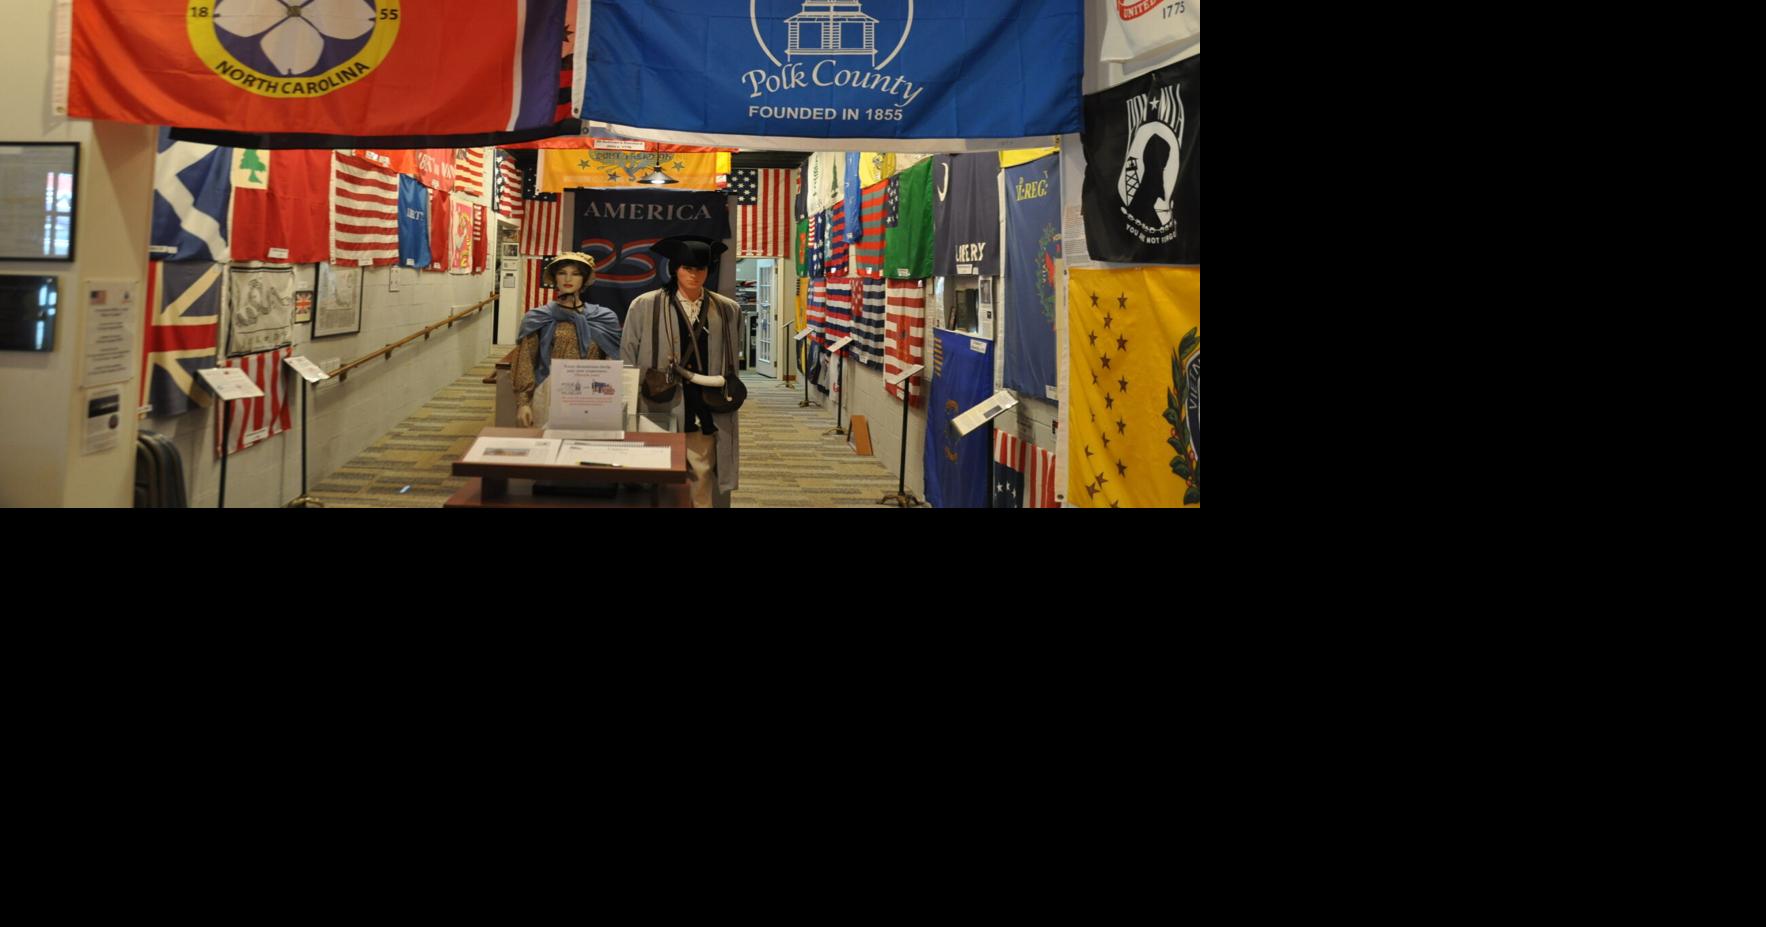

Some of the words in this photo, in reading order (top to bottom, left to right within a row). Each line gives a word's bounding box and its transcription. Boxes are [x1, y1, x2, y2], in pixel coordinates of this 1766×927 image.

[191, 6, 209, 17] 18
[379, 8, 399, 20] 55
[1162, 1, 1185, 19] 1775
[215, 60, 279, 94] NORTH
[281, 61, 371, 94] CAROLINA
[742, 62, 809, 98] Polk
[812, 59, 924, 107] County
[748, 105, 837, 120] FOUNDED
[842, 108, 859, 120] IN
[865, 108, 903, 121] 1855
[583, 201, 712, 221] AMERICA
[1126, 223, 1139, 237] YOU
